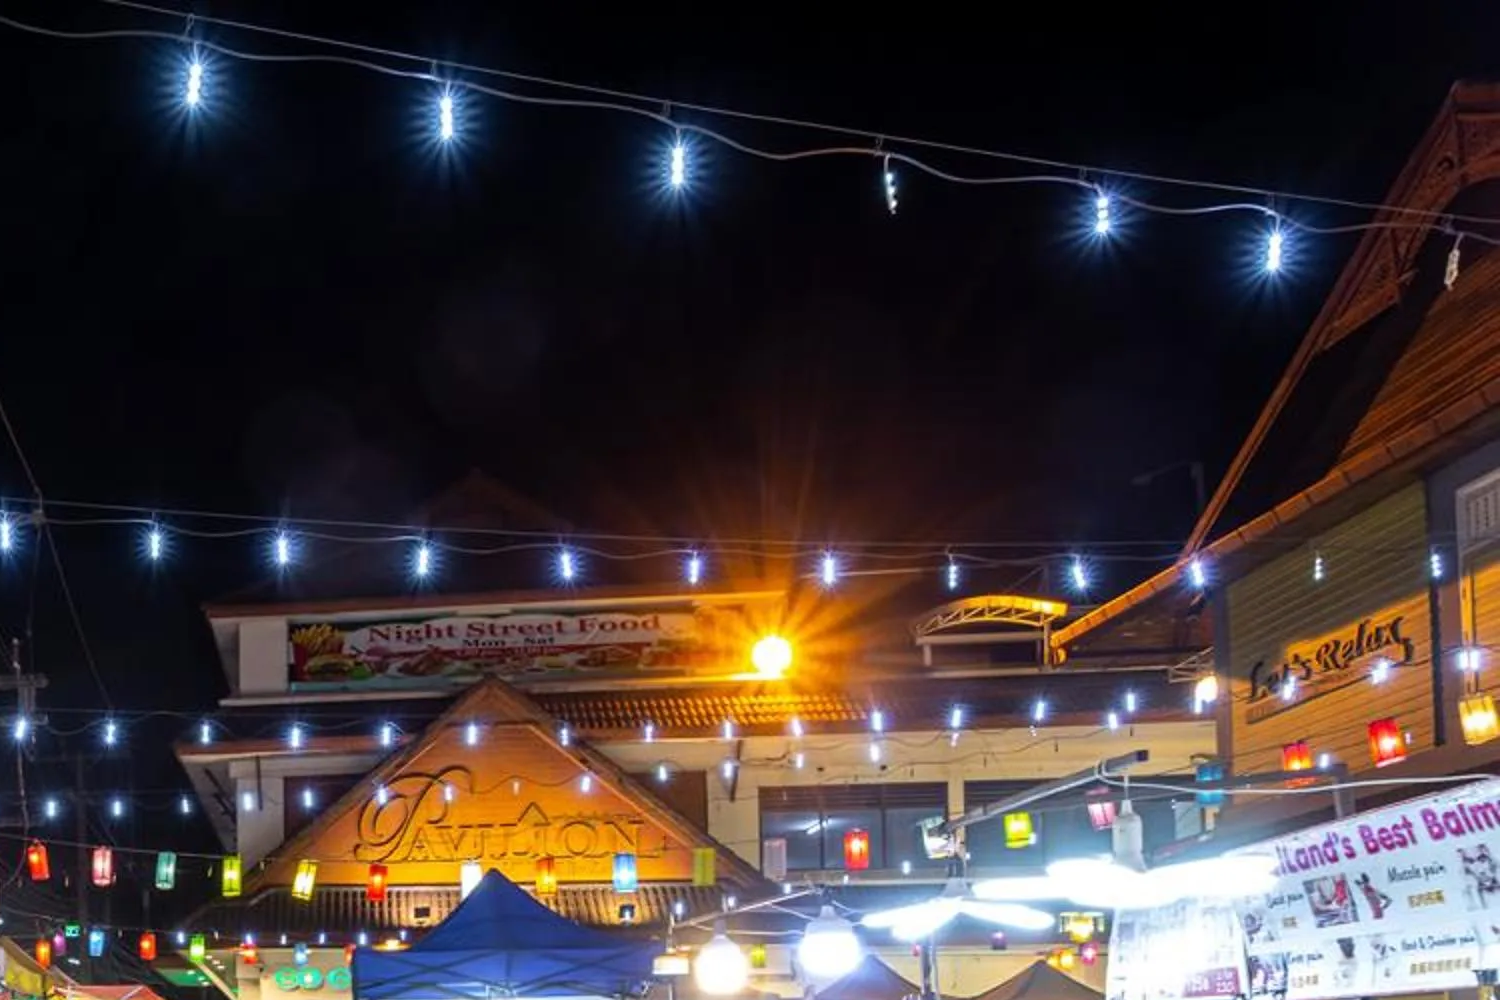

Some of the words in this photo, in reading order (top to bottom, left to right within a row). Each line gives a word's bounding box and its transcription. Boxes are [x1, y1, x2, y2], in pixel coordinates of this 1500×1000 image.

[368, 624, 456, 644] Night
[465, 620, 564, 638] Street
[579, 615, 660, 634] Food
[462, 639, 508, 648] Mon
[1315, 616, 1414, 672] Relax
[1358, 815, 1418, 855] Best
[1420, 801, 1500, 841] Balm
